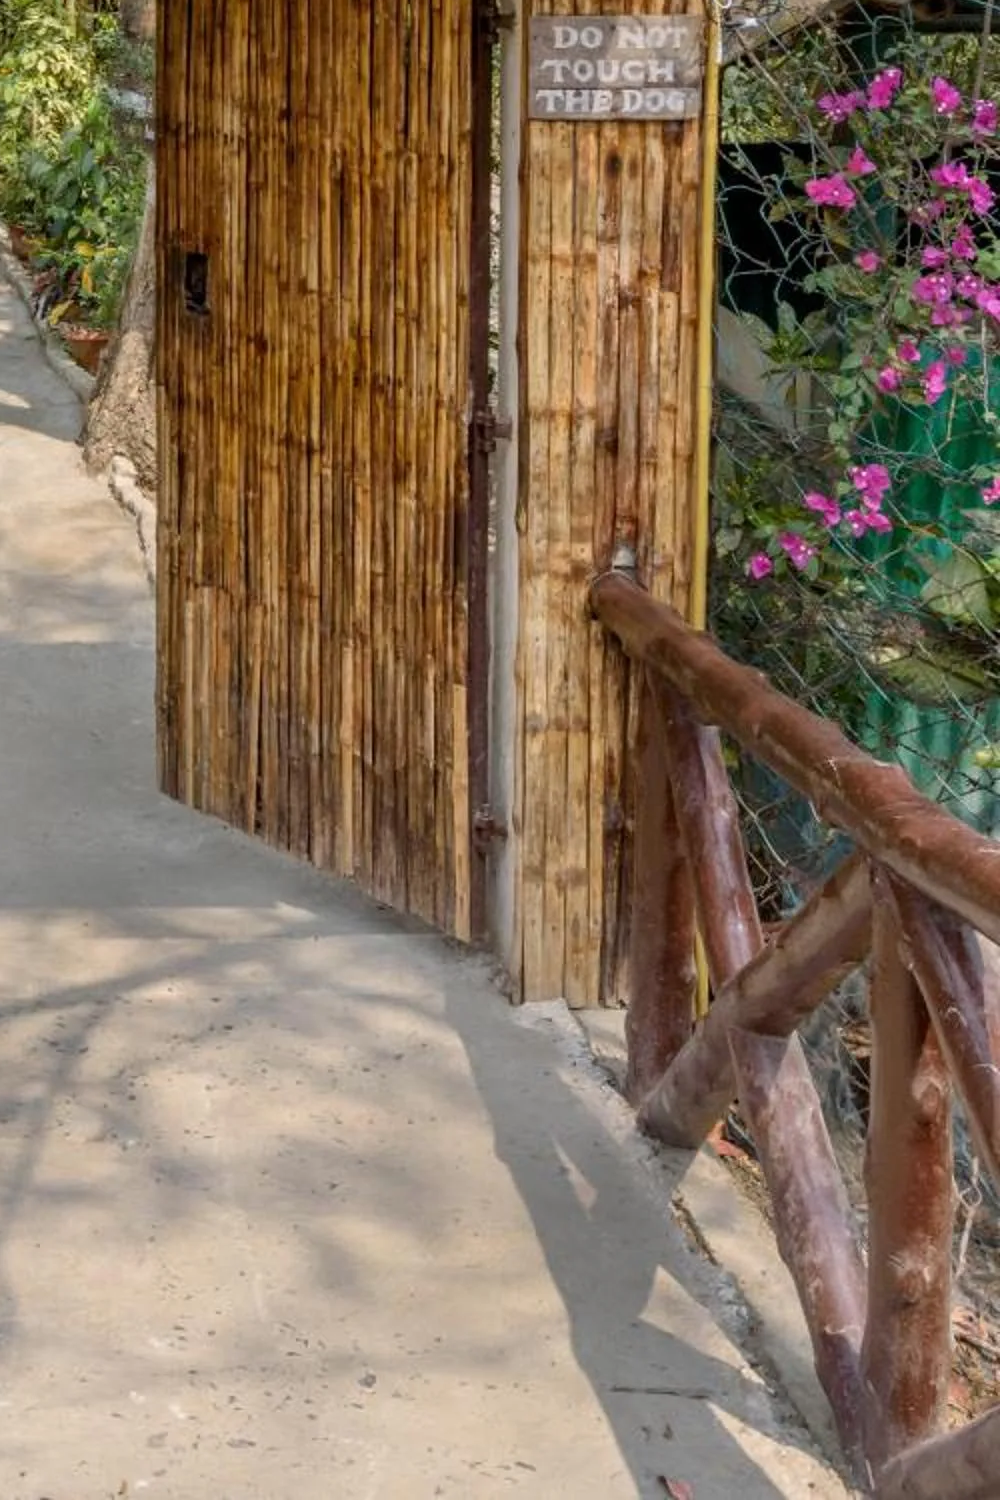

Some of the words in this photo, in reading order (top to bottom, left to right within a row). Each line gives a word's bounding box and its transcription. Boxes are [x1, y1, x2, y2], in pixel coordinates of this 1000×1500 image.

[552, 25, 603, 49] DO
[615, 25, 688, 49] NOT
[540, 59, 675, 83] TOUCH
[536, 88, 612, 113] THE
[621, 88, 686, 113] DOG
